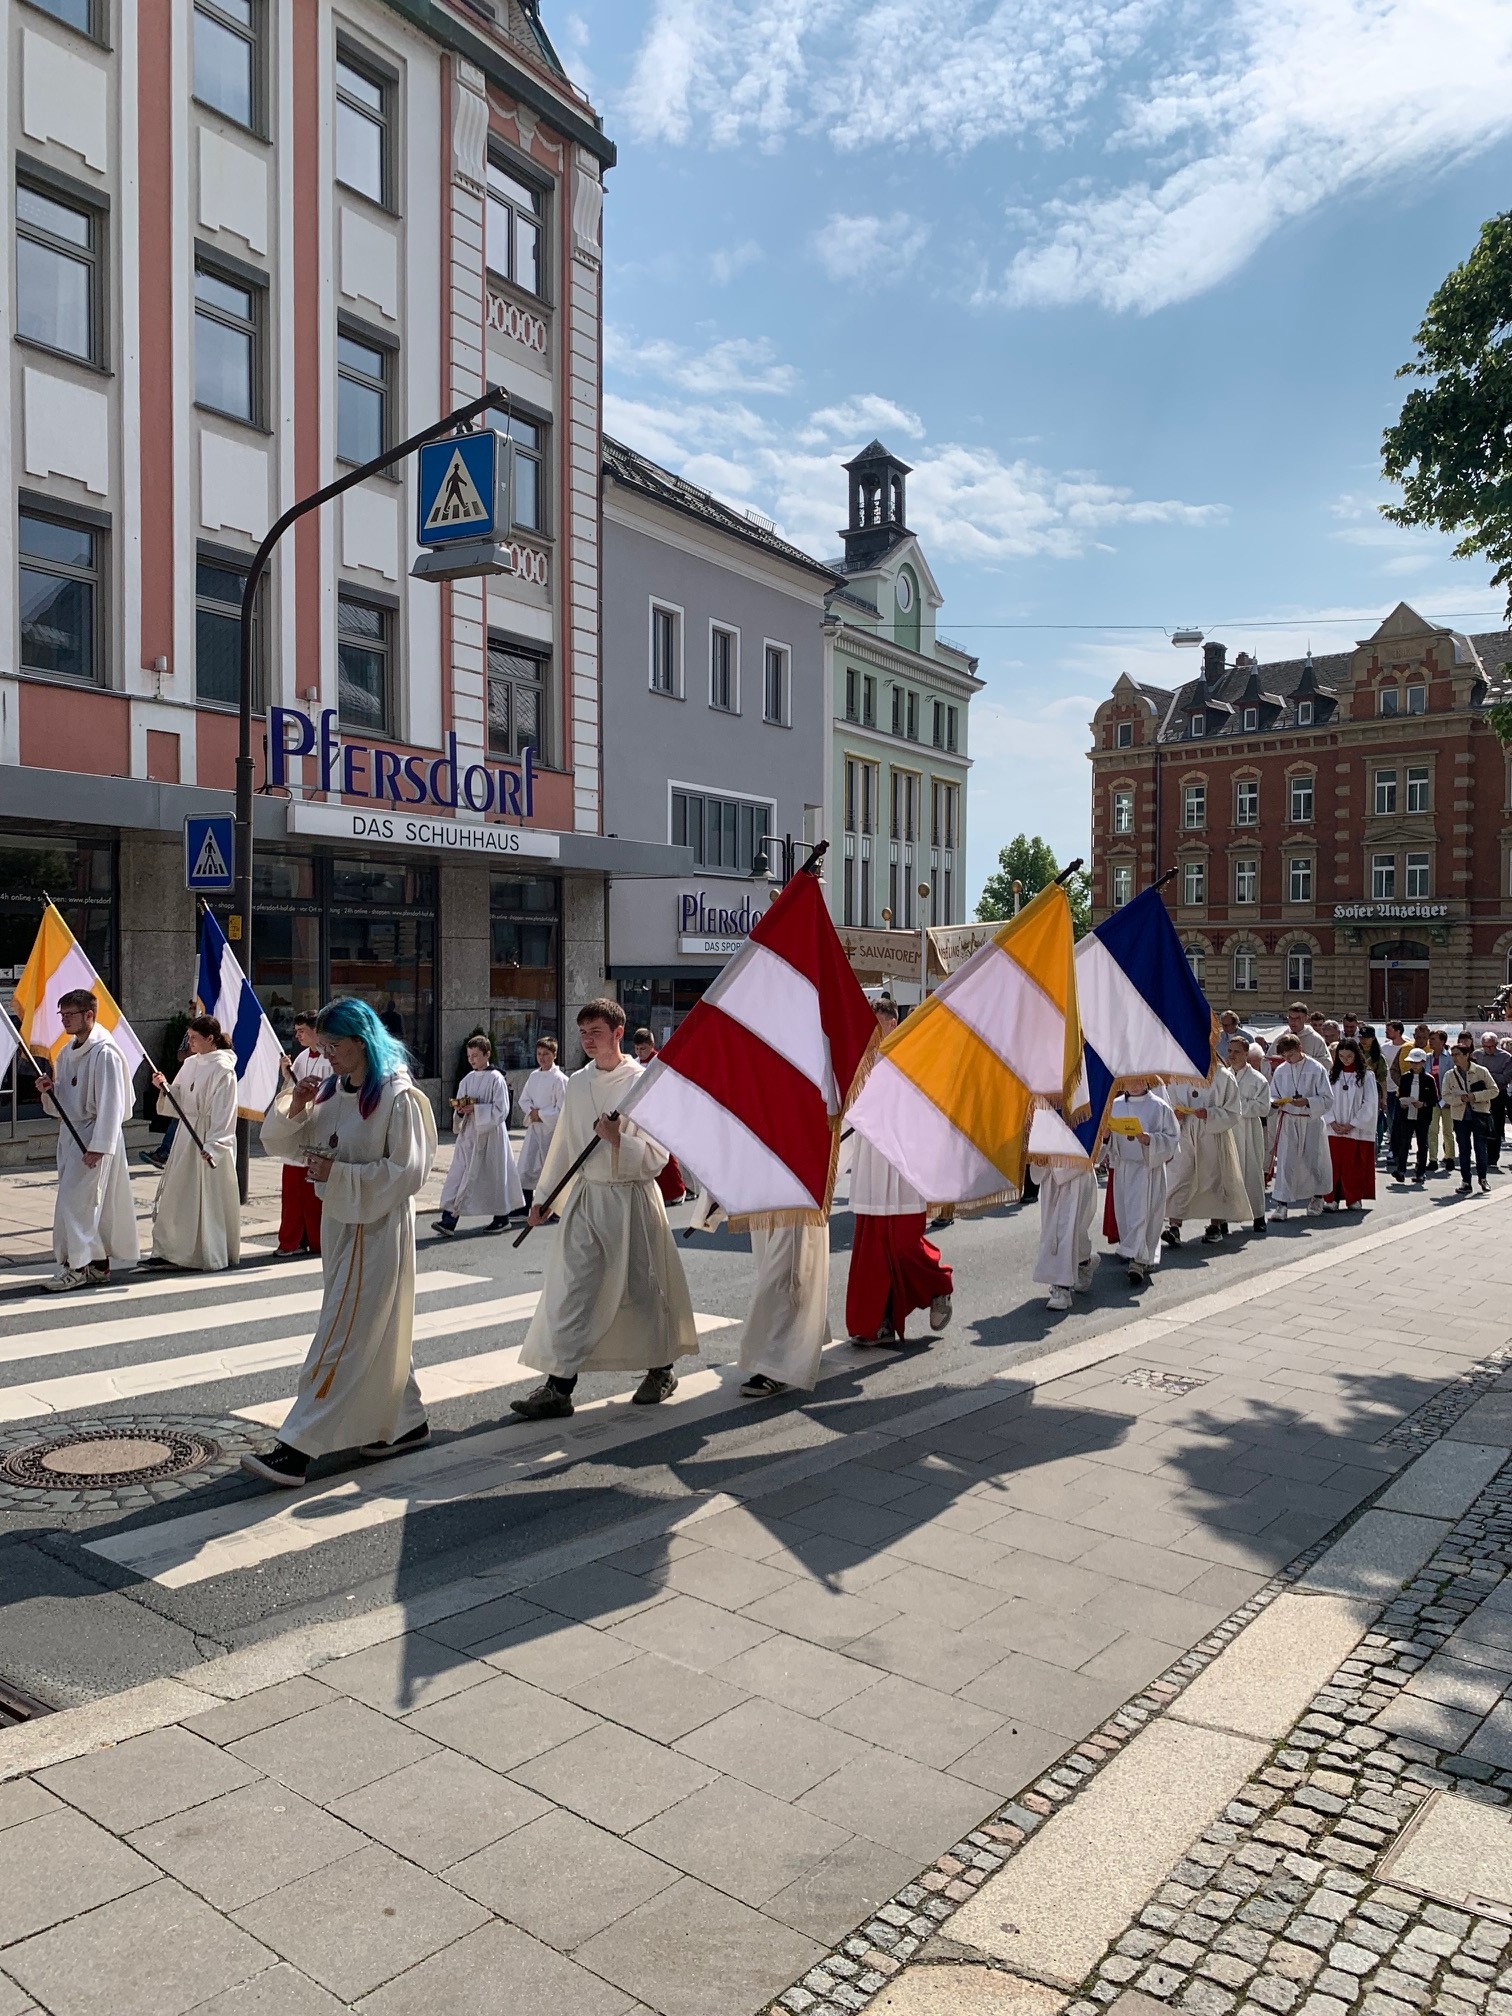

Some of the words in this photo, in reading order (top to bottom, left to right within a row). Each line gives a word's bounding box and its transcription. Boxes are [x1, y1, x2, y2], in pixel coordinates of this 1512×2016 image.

[352, 816, 394, 839] DAS
[405, 822, 520, 851] SCHUHHAUS
[1333, 904, 1374, 919] Hofer
[1376, 902, 1448, 918] Anzeiger
[704, 941, 720, 952] DAS
[721, 942, 743, 952] SPOR
[859, 945, 922, 964] SALVATOREM
